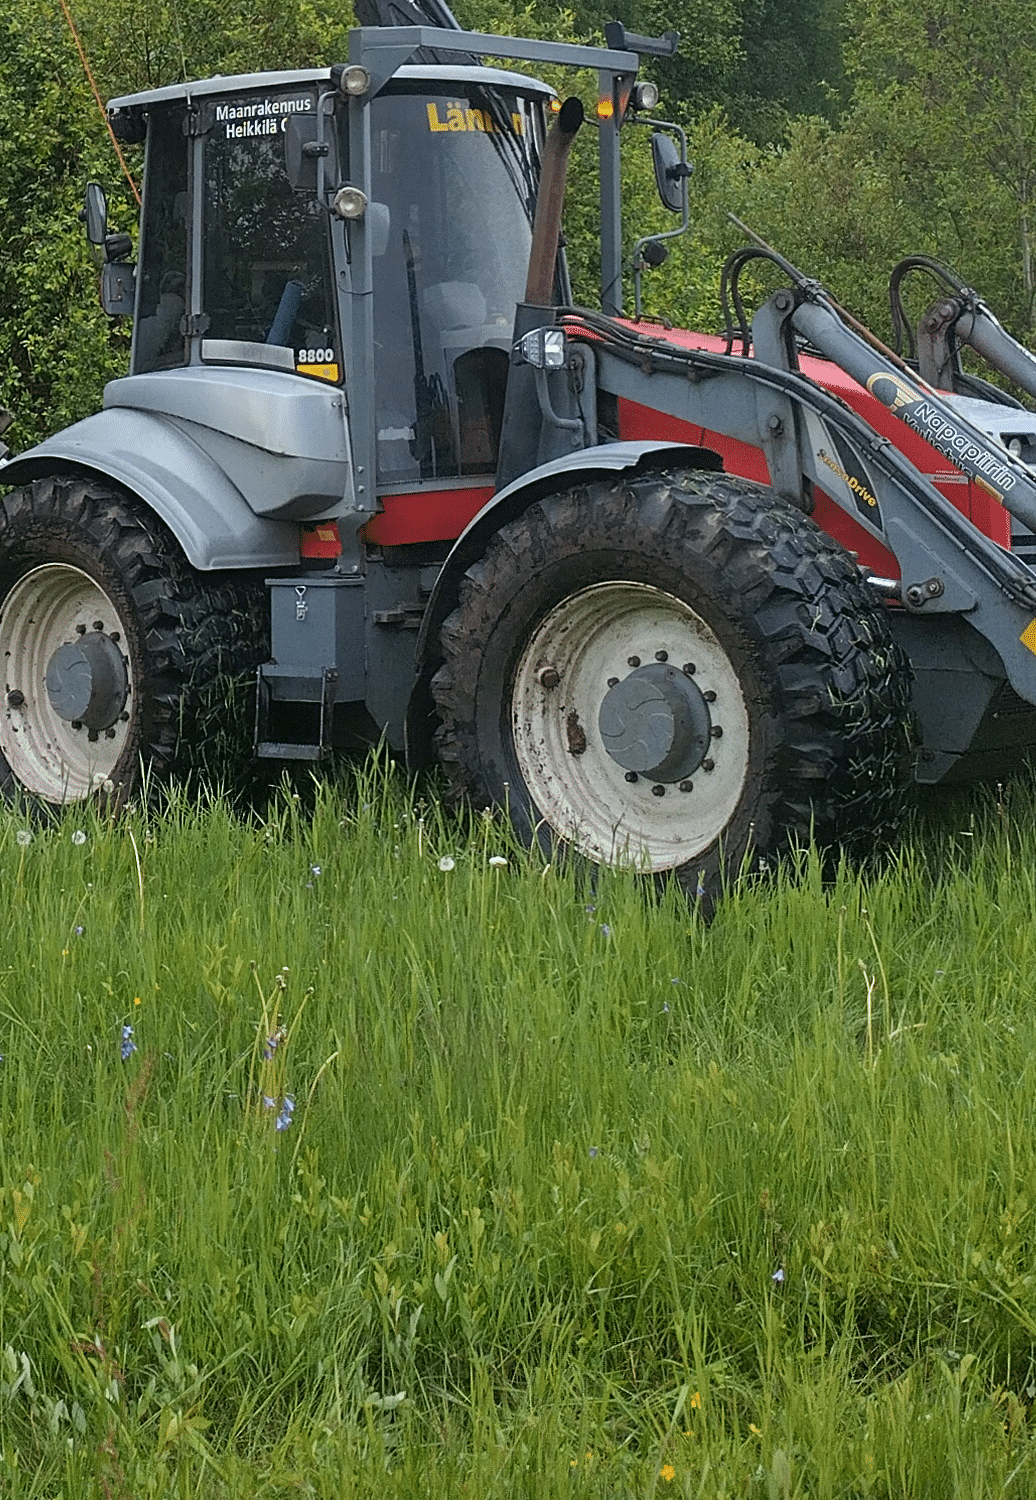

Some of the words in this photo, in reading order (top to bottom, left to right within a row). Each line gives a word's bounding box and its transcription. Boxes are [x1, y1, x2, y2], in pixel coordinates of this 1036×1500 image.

[216, 98, 311, 121] Maanrakennus
[226, 118, 278, 139] Heikkilä
[298, 348, 335, 363] 8800
[914, 402, 1017, 491] Napapiirin
